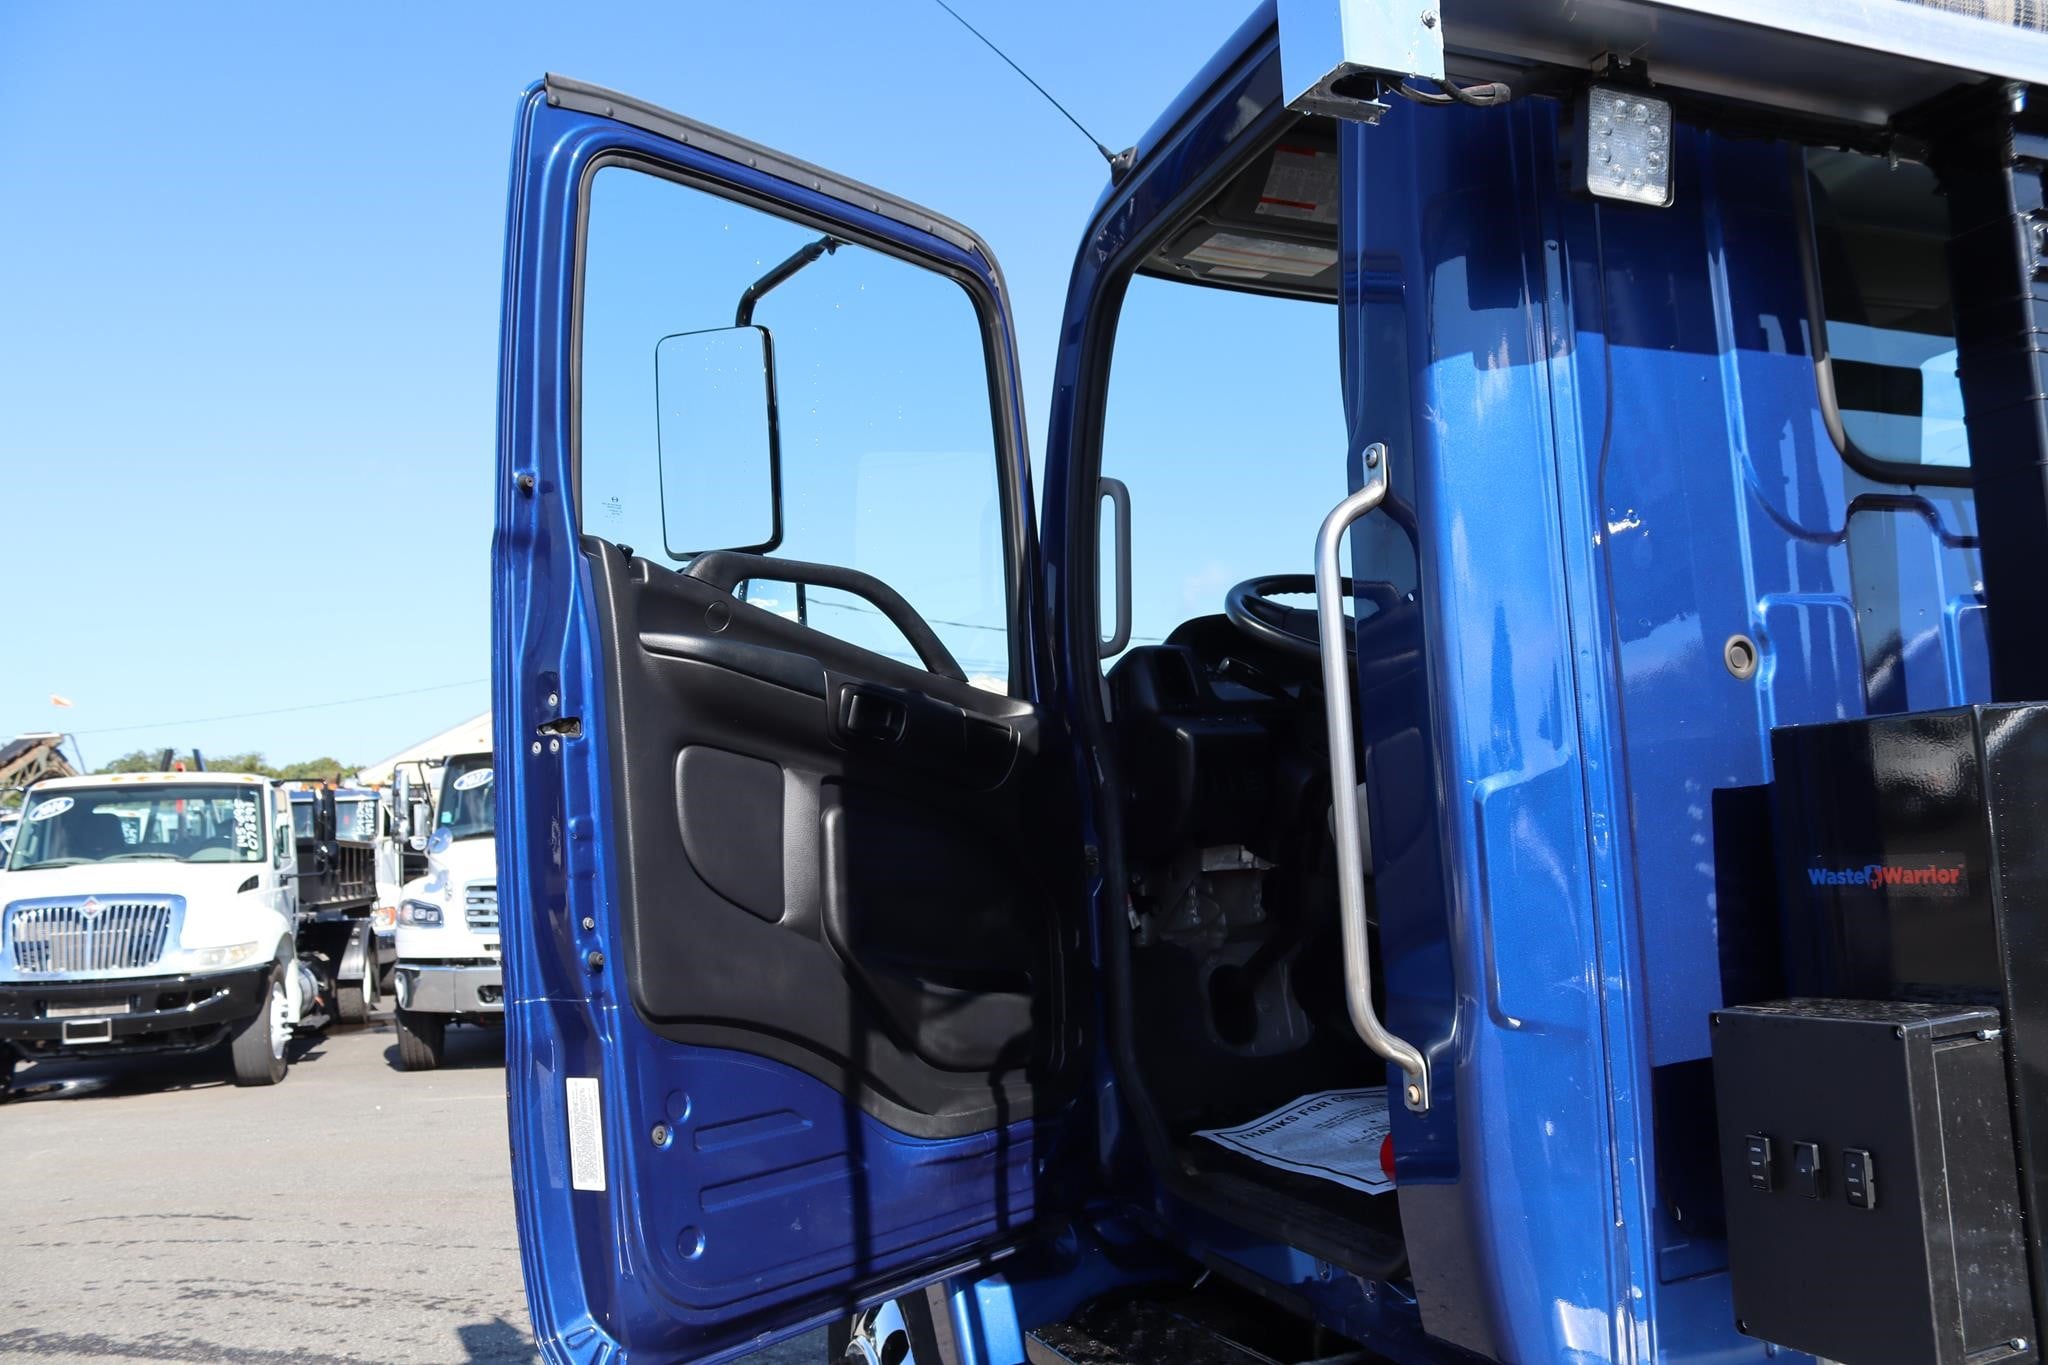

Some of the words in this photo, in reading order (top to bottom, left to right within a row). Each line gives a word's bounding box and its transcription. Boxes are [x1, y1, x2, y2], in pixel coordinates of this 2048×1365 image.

[1808, 868, 1865, 885] Waste
[1882, 866, 1960, 885] Warrior
[1237, 1114, 1299, 1140] THANKS
[1299, 1100, 1332, 1117] FOR
